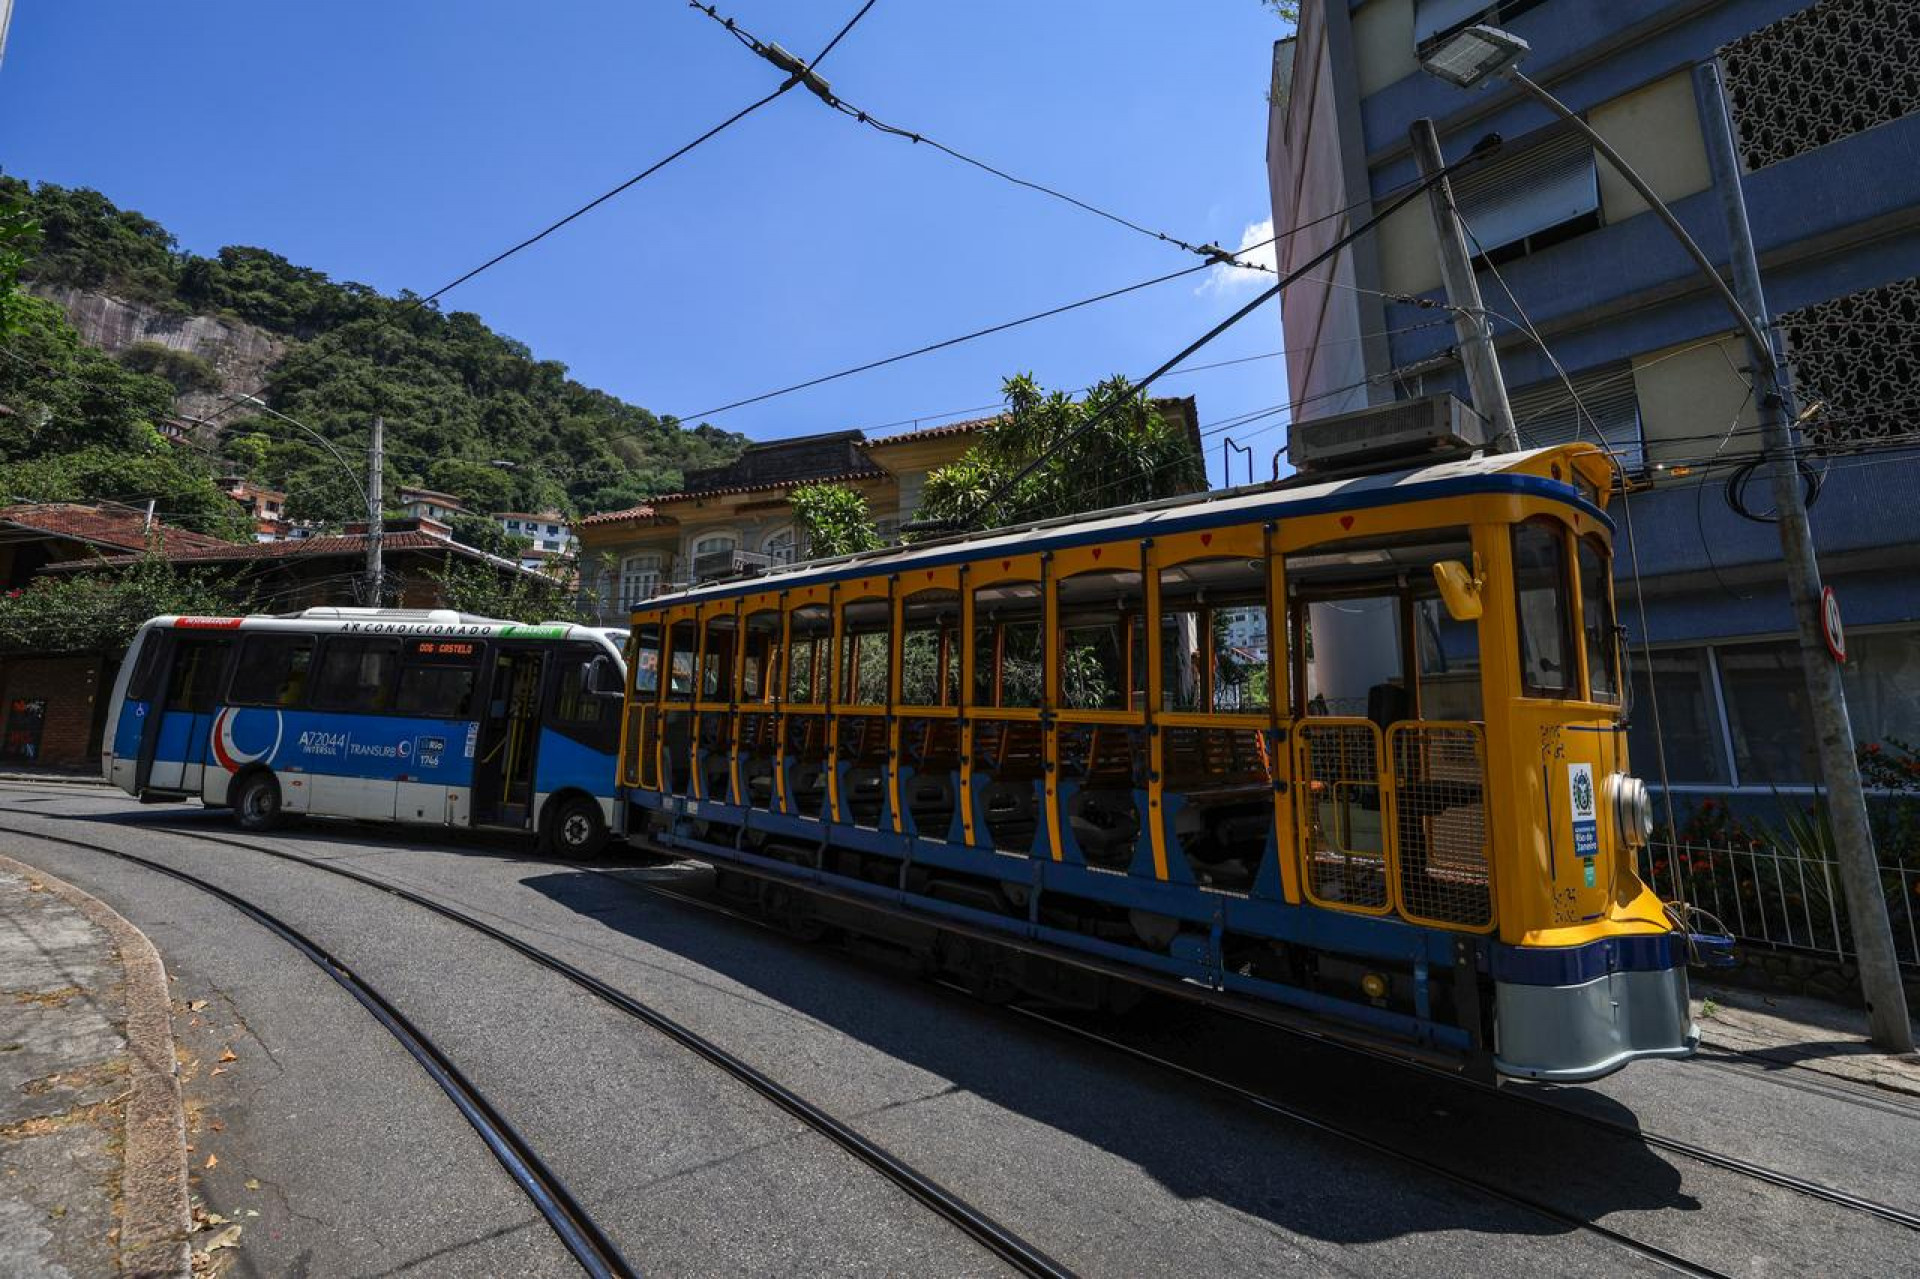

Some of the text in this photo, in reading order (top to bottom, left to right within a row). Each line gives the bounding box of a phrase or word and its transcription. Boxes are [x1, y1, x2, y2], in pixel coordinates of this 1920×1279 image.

[340, 623, 492, 635] AR CONDICIONADO
[439, 644, 472, 655] CASTELO
[299, 731, 346, 748] A72044
